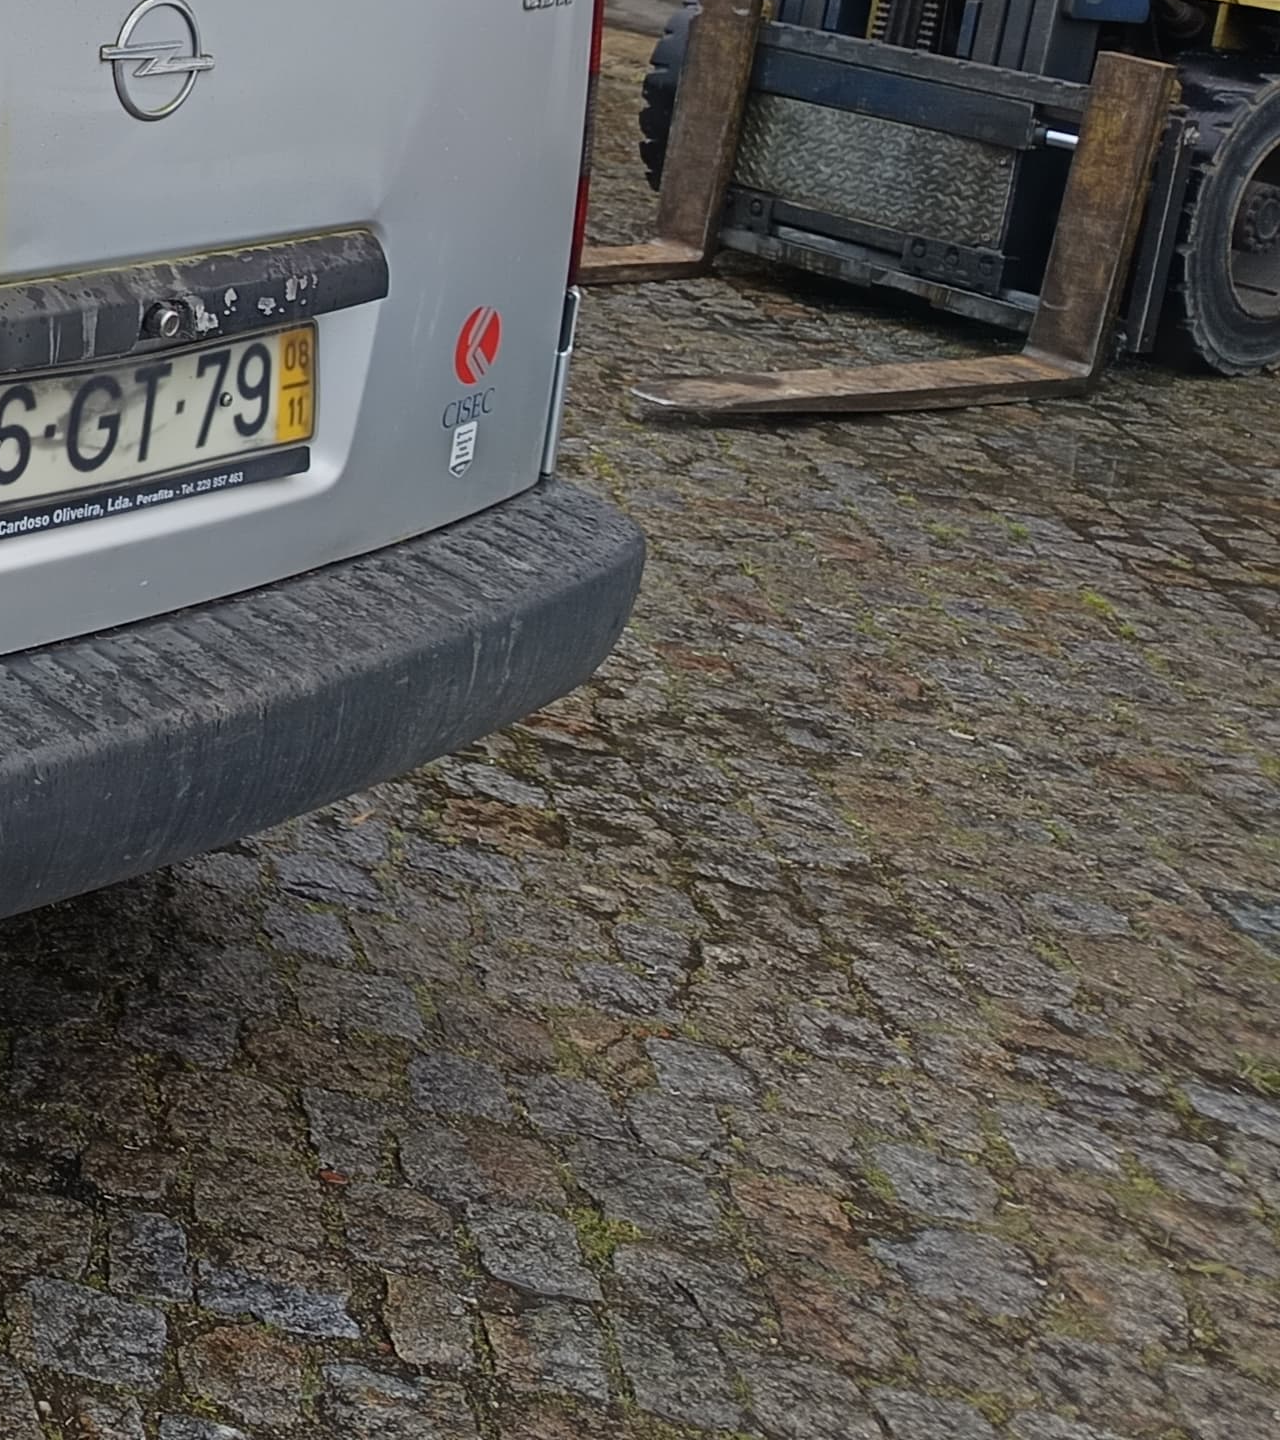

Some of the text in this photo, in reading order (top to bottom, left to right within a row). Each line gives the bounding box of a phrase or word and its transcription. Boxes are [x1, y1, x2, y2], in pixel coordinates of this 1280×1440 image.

[284, 338, 310, 372] 08
[287, 397, 305, 428] 11
[442, 387, 495, 429] CISEC
[53, 503, 104, 523] Oliveira,
[107, 496, 133, 512] Lda.
[136, 489, 174, 505] Perafita
